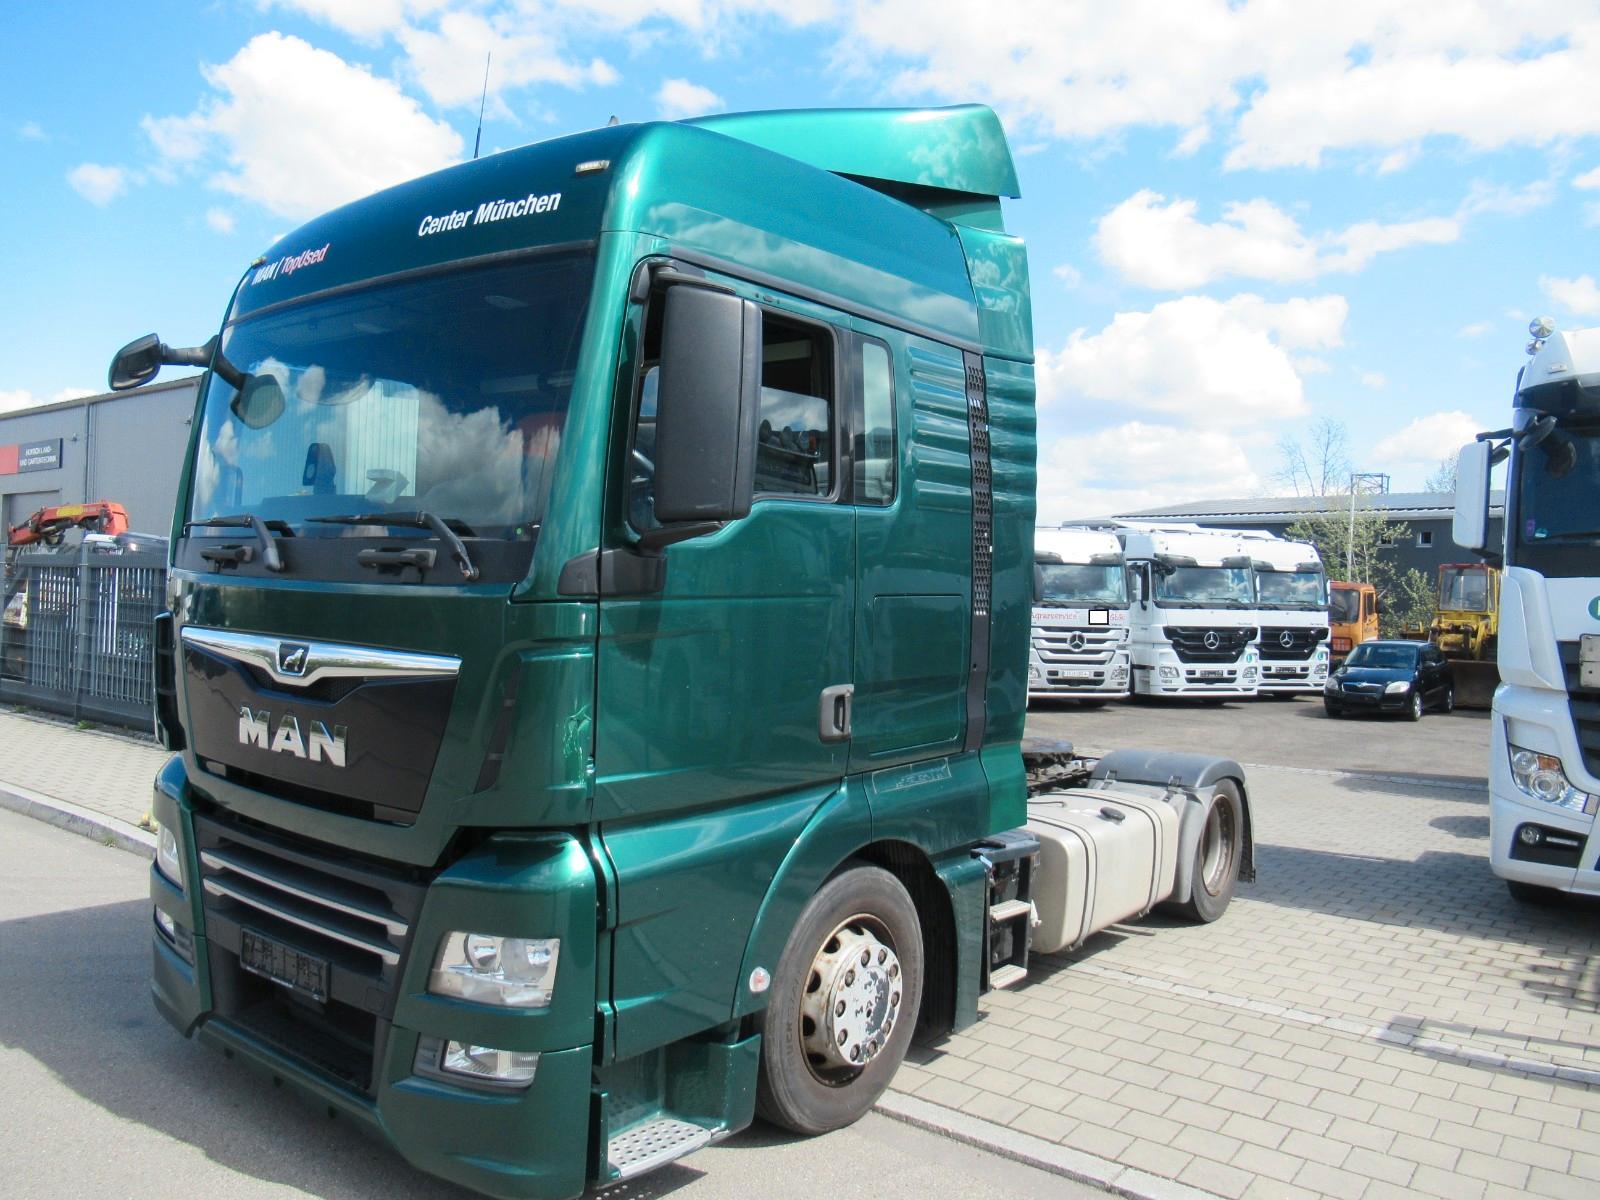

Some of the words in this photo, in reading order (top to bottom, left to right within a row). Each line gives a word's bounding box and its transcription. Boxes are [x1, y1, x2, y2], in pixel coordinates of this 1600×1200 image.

[418, 210, 474, 237] Center
[473, 192, 562, 225] München
[251, 261, 279, 286] MAN
[281, 242, 330, 275] TopUsed
[239, 706, 347, 768] MAN
